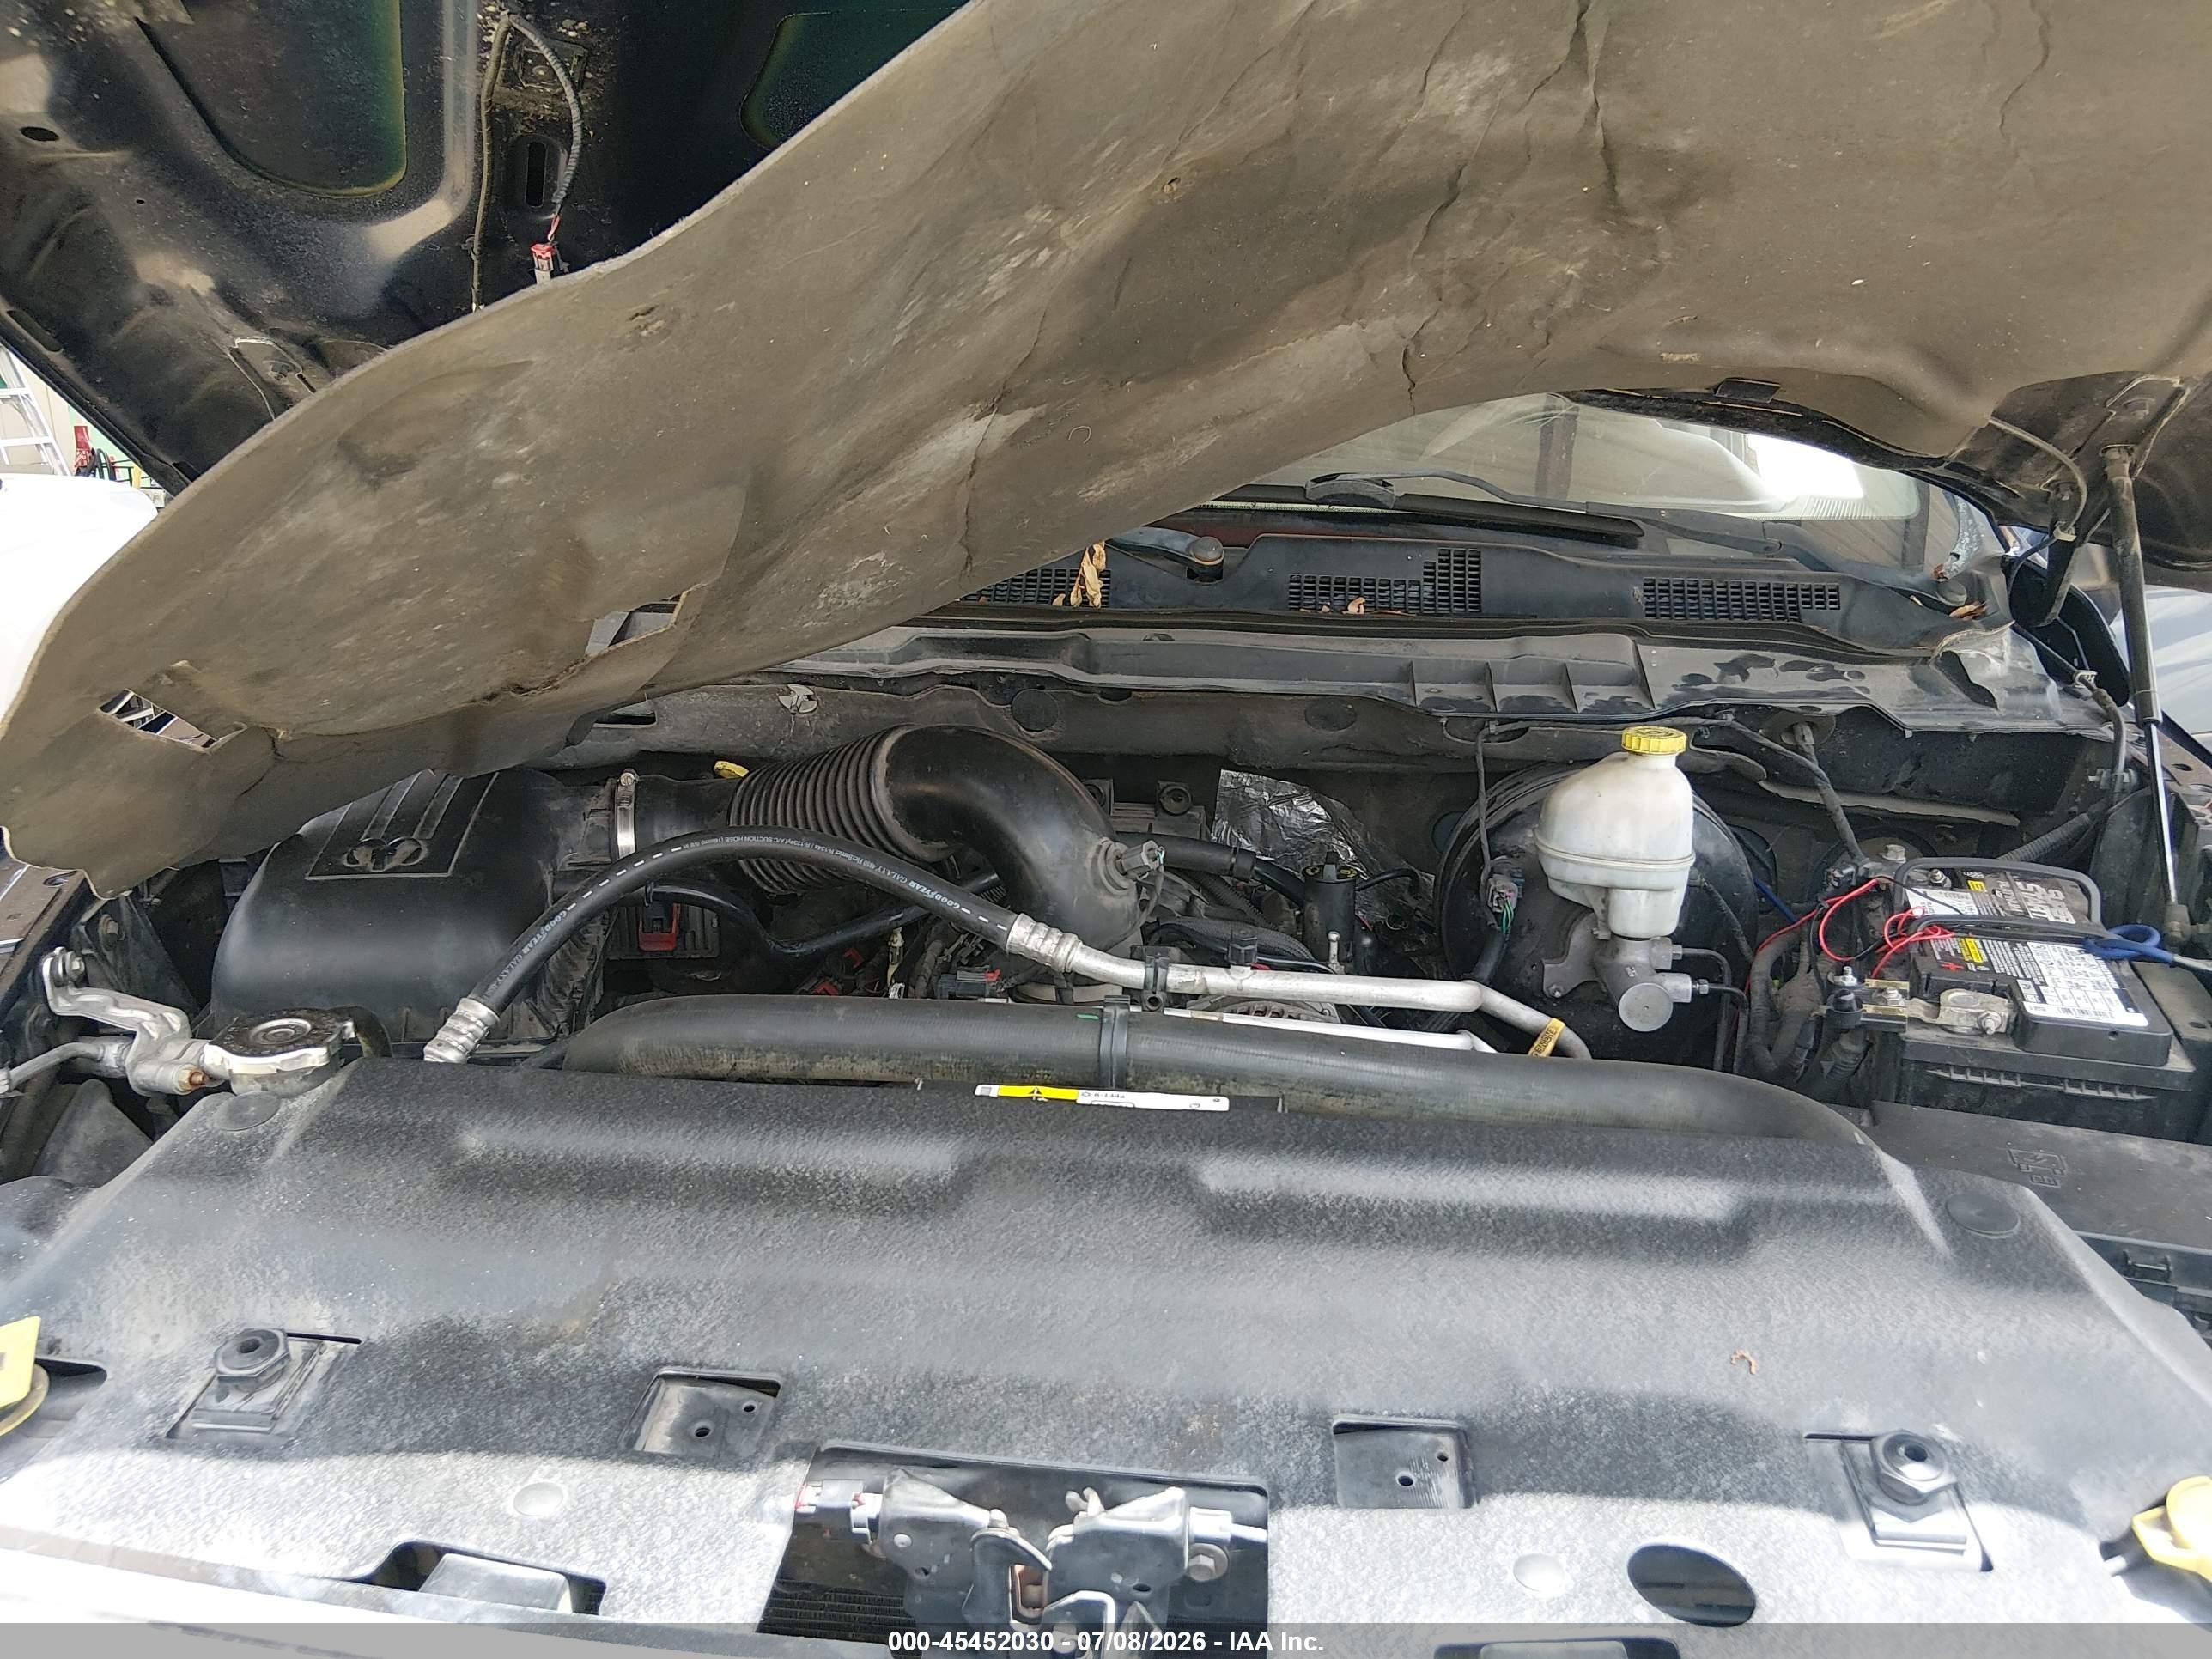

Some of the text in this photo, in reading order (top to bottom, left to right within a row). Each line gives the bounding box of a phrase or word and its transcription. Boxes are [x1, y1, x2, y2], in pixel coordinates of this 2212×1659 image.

[874, 865, 908, 884] GALAXY
[908, 879, 962, 910] GOODYEAR
[1996, 879, 2024, 914] PLATINUM
[2015, 880, 2051, 920] START
[2045, 888, 2077, 925] SUPER
[521, 910, 568, 954] GOODYEAR
[1534, 1026, 1558, 1054] ENGINE
